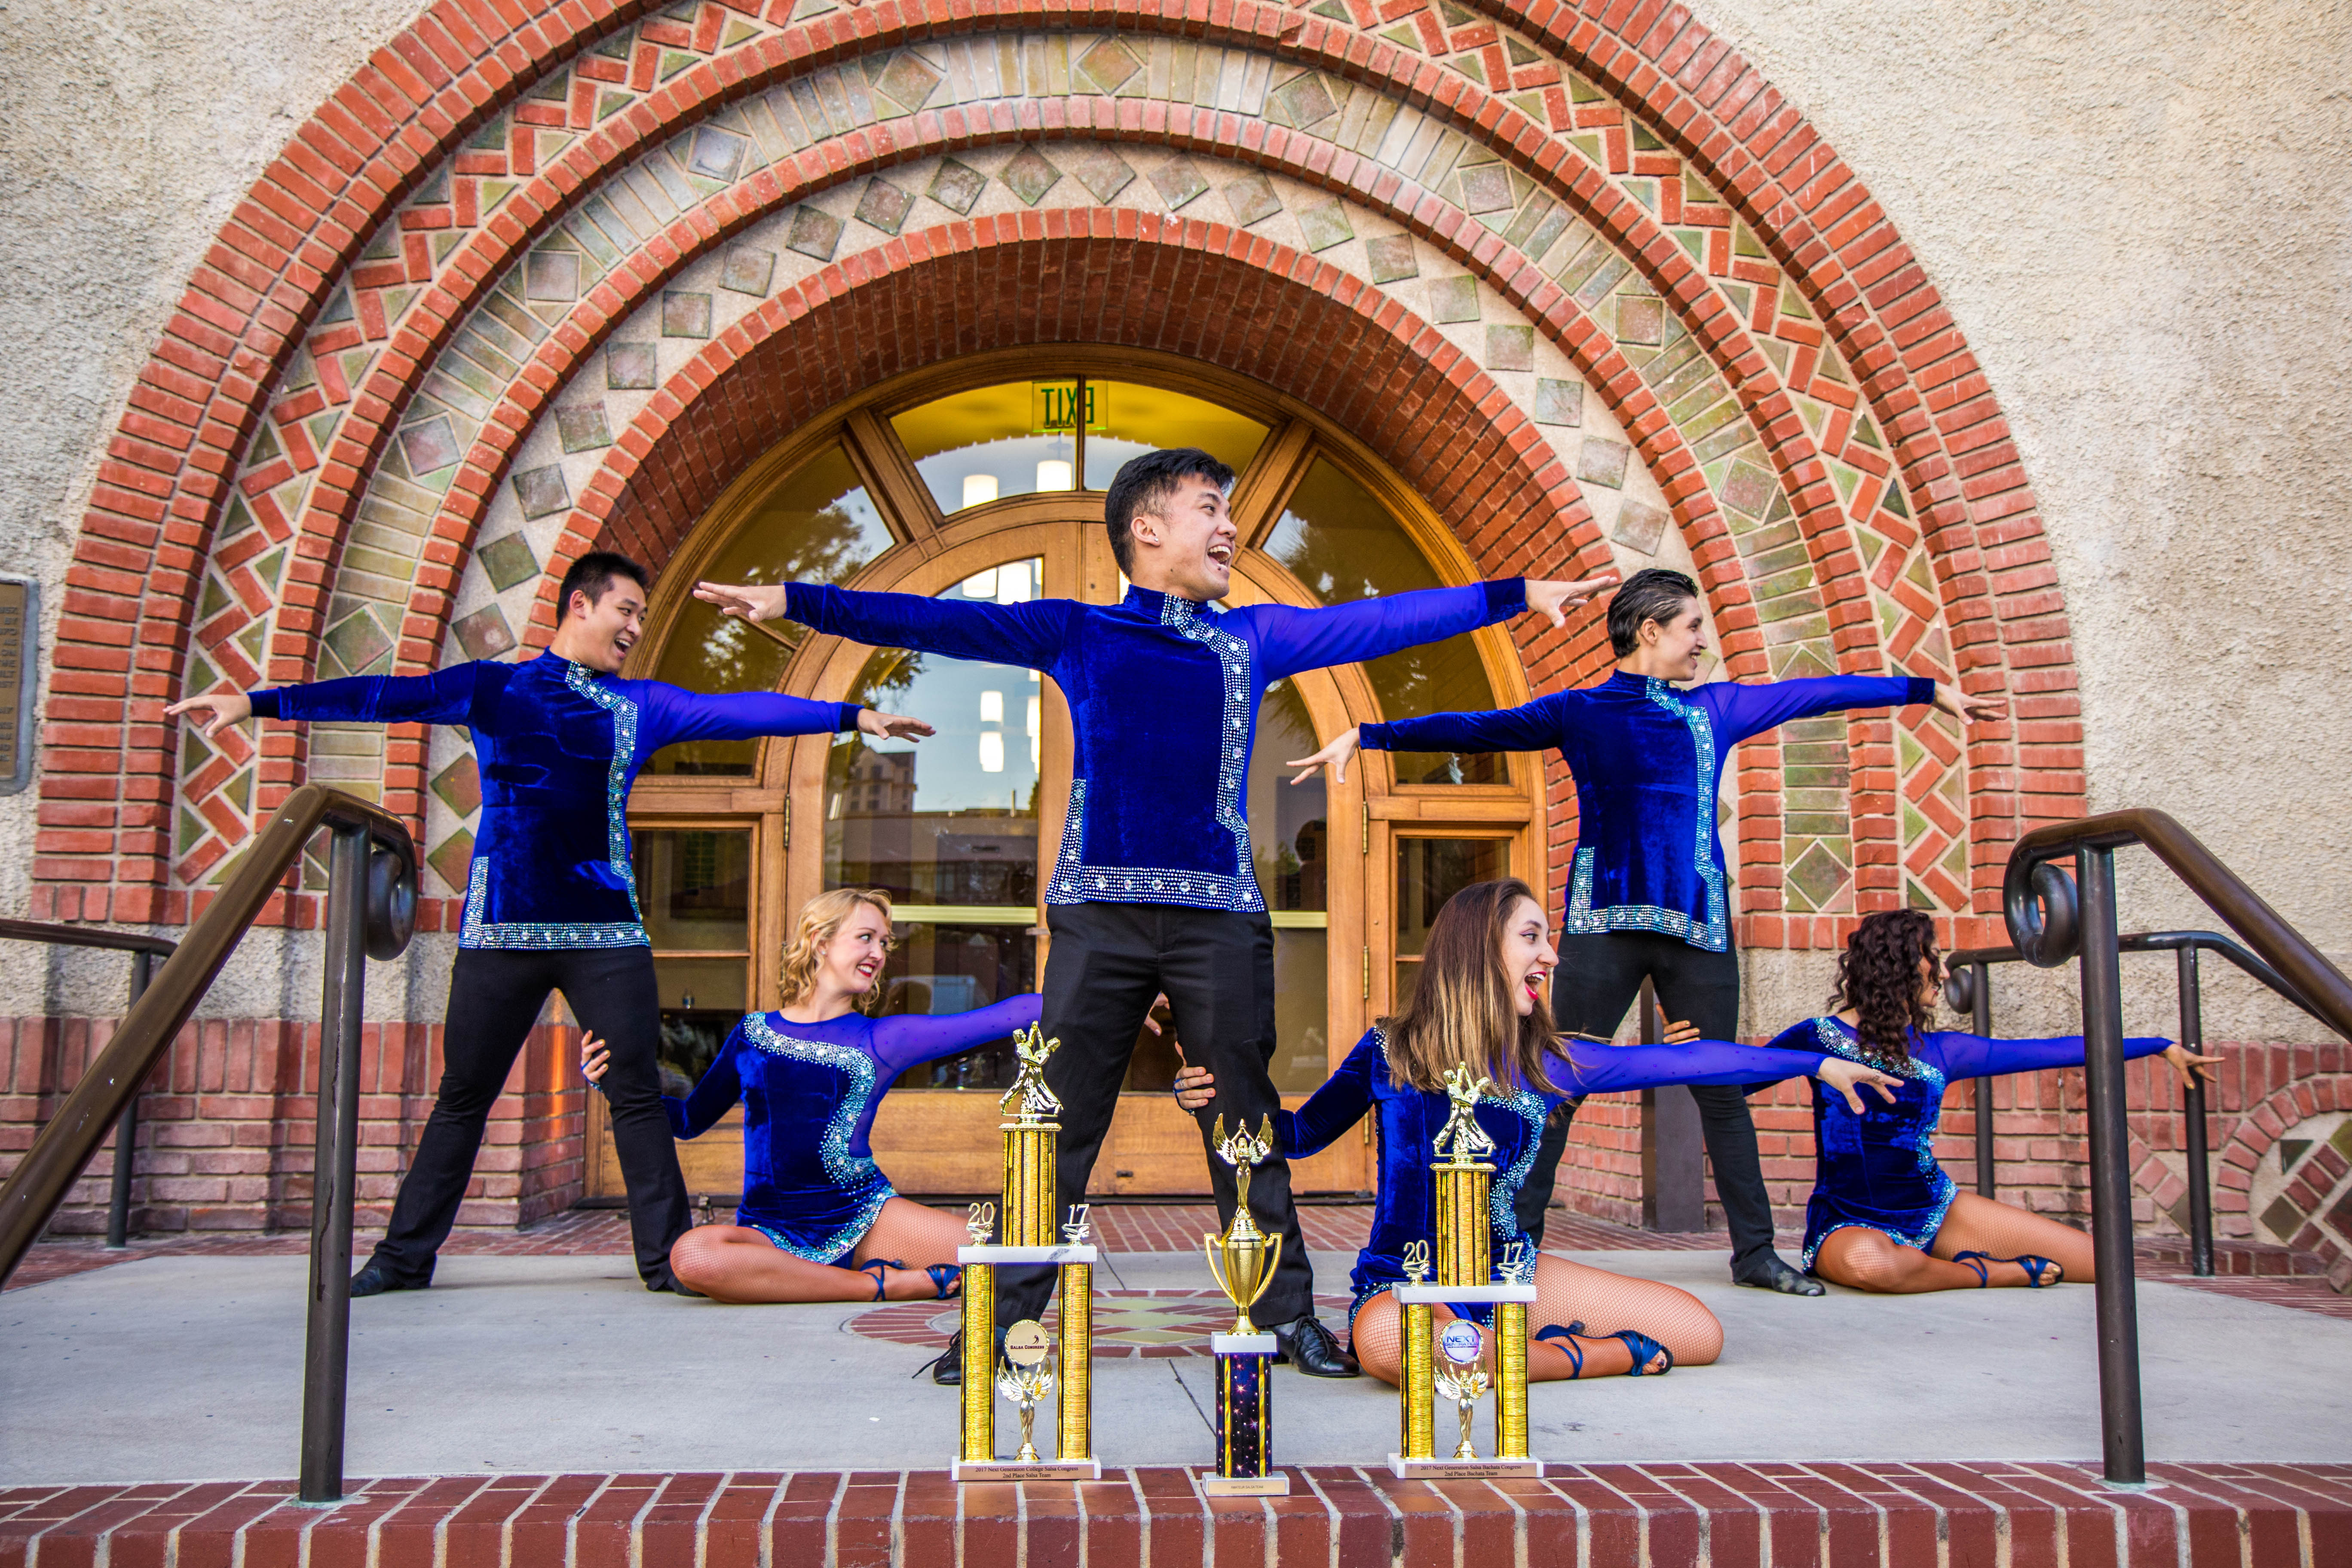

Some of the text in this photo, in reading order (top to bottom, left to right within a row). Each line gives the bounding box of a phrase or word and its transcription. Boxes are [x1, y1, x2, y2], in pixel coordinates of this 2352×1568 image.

[968, 1202, 1090, 1225] 20 17
[1403, 1240, 1524, 1265] 20 17
